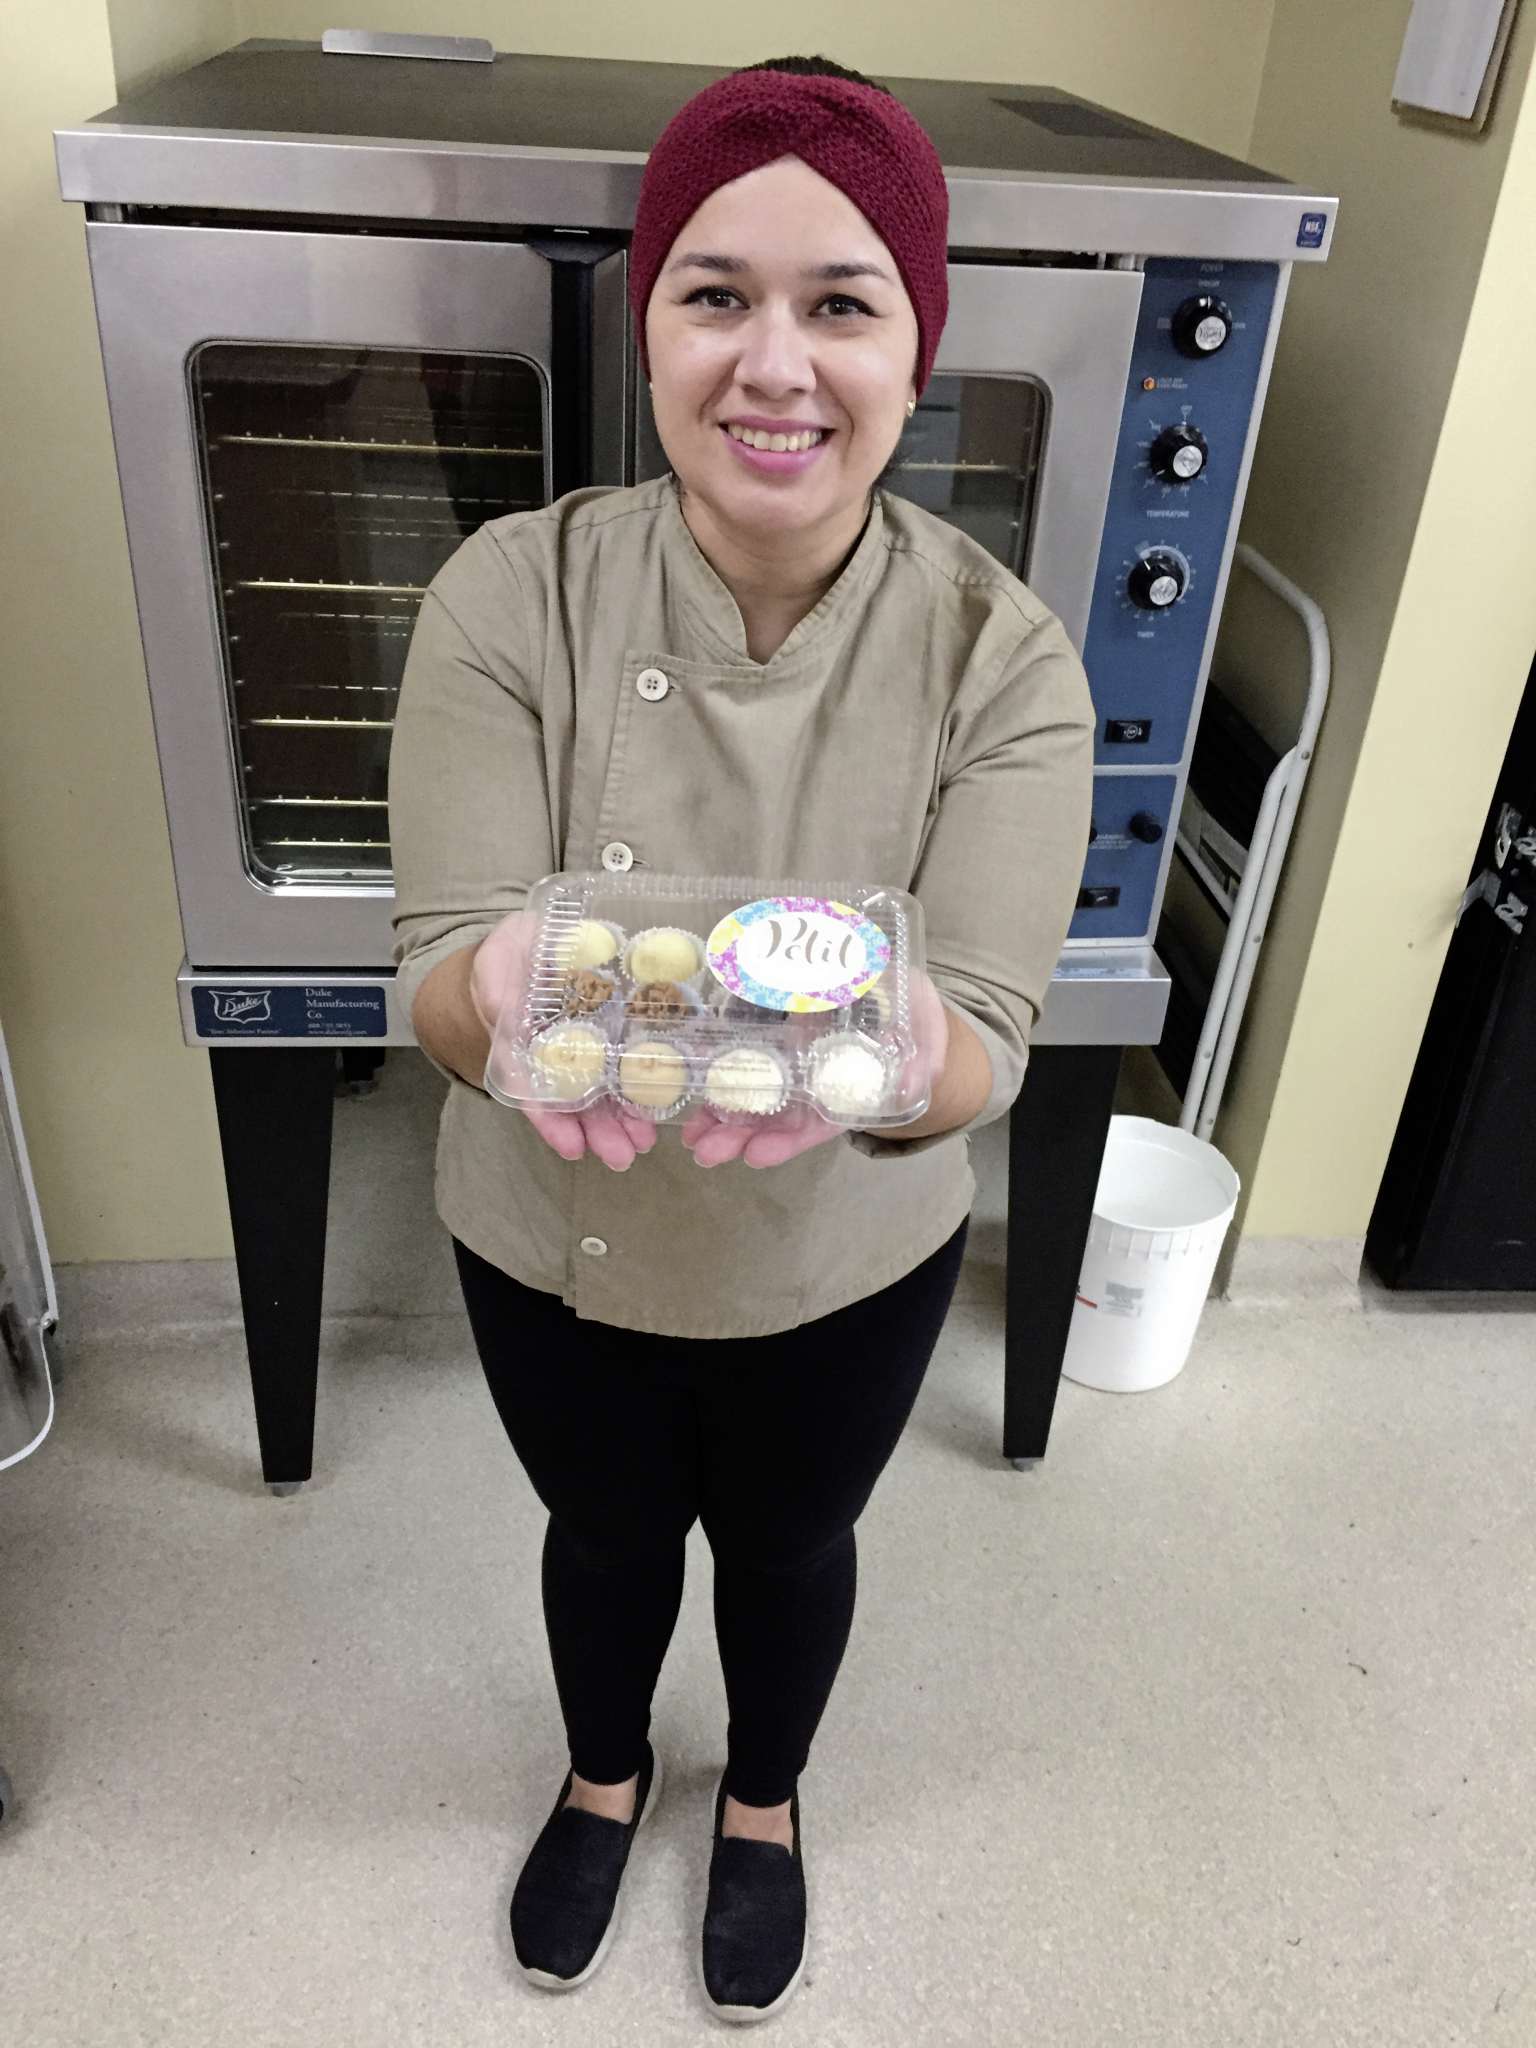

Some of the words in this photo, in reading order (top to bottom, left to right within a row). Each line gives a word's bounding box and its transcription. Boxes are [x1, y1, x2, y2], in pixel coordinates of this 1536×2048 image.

[305, 988, 333, 998] Duke
[222, 996, 262, 1016] Duke
[305, 999, 380, 1011] Manufacturing
